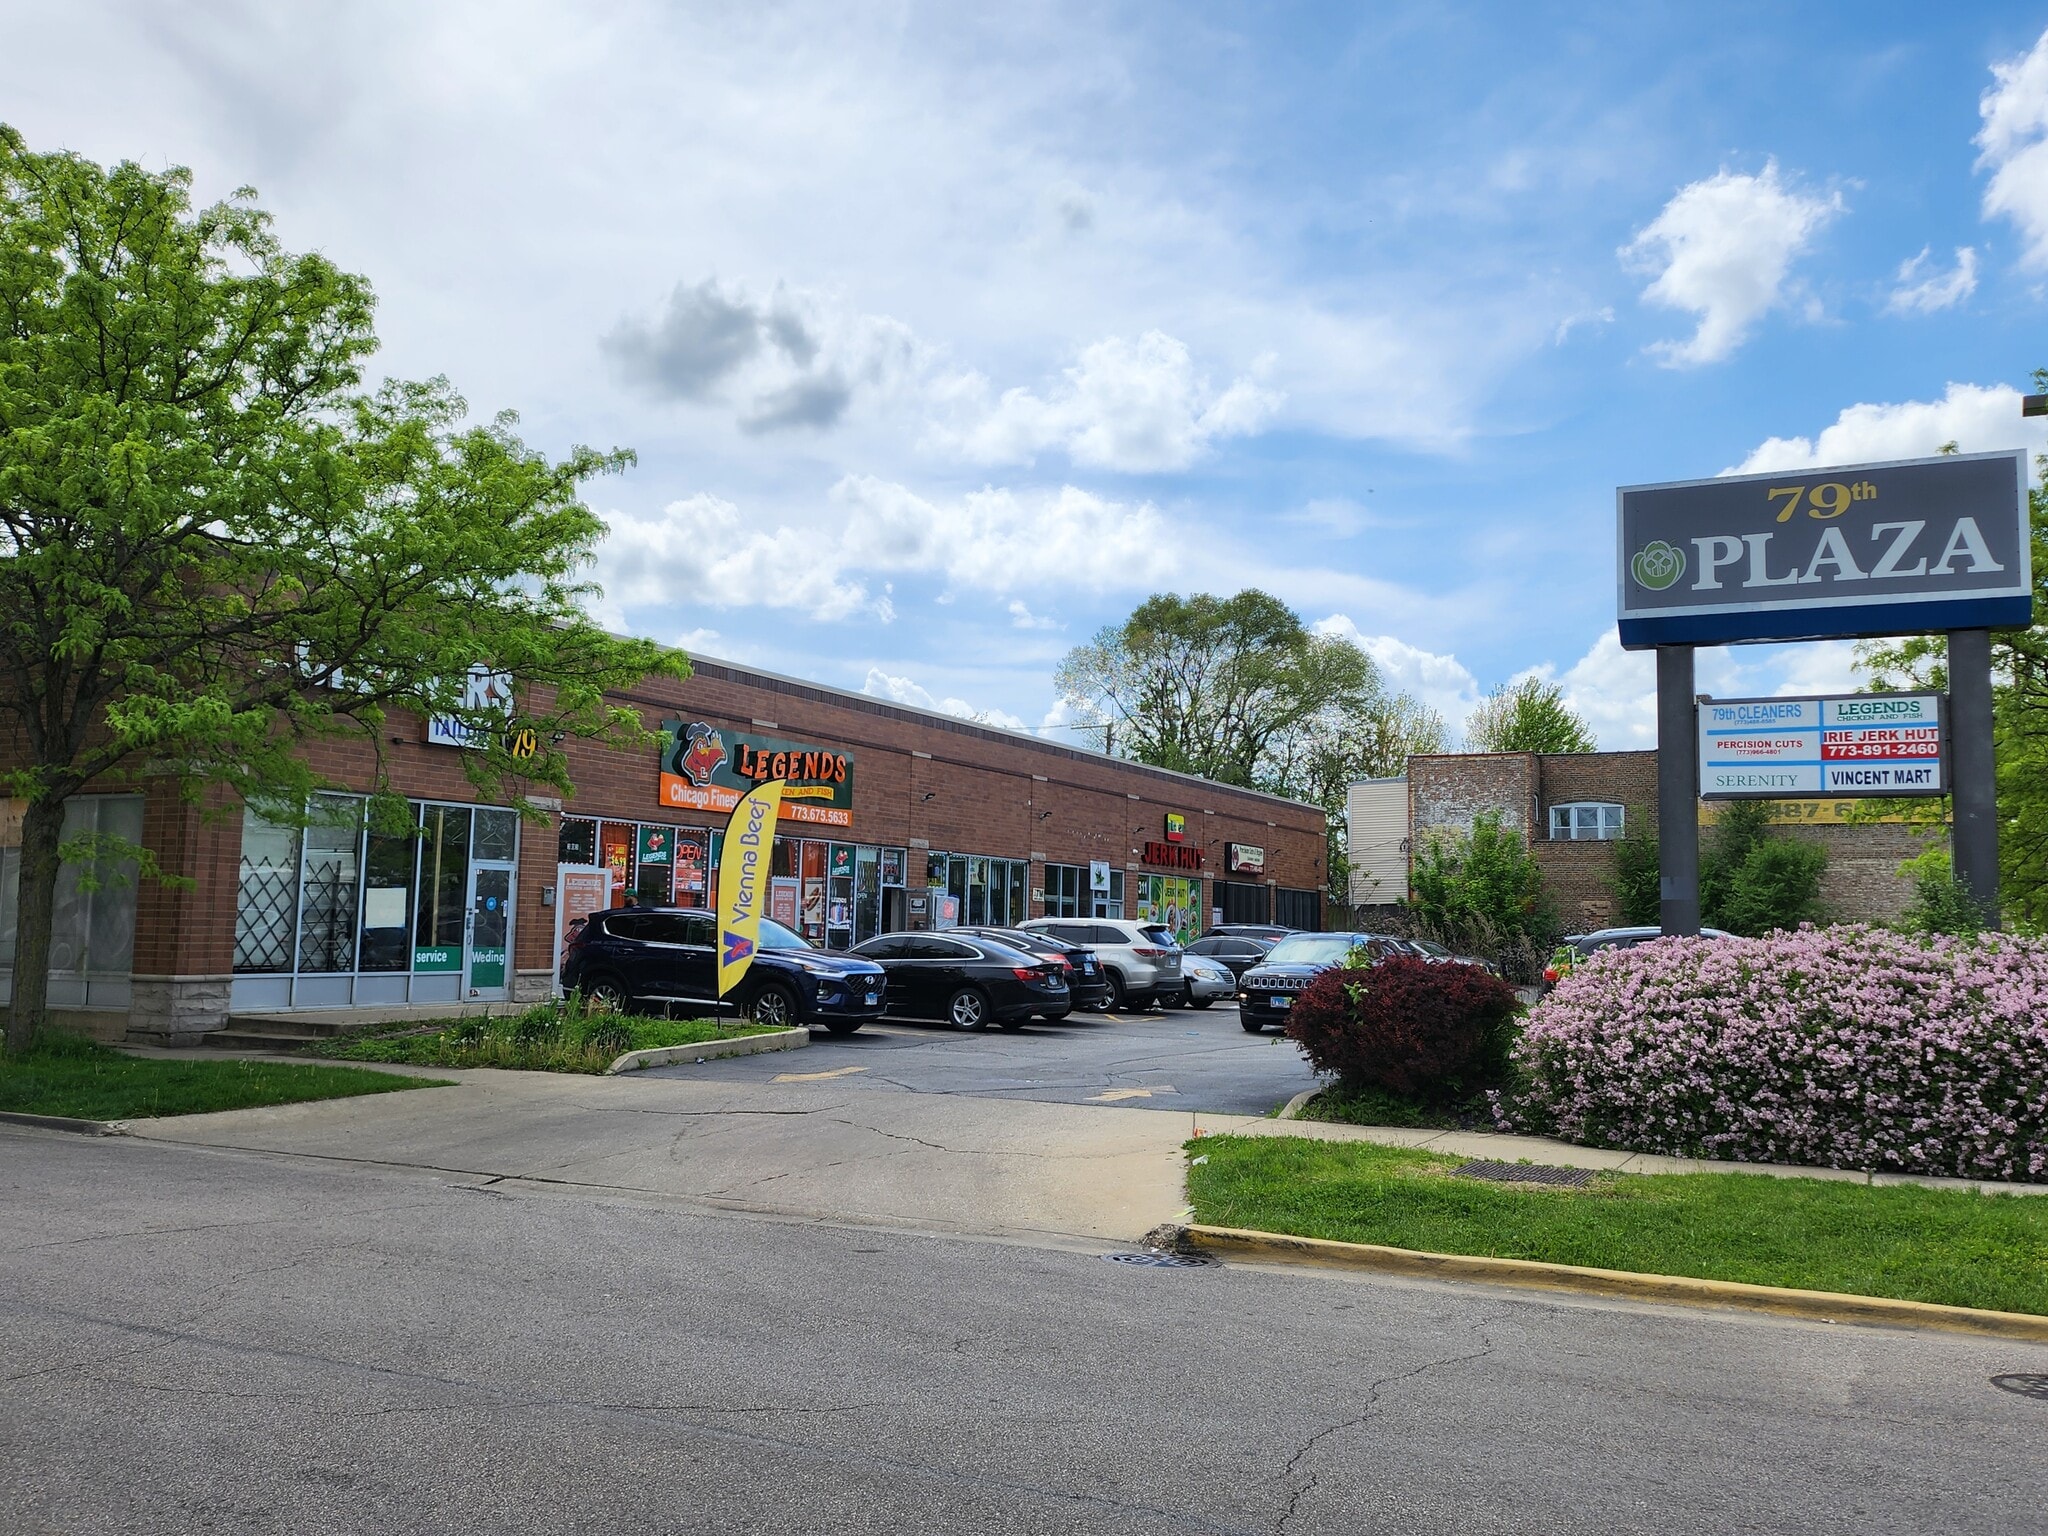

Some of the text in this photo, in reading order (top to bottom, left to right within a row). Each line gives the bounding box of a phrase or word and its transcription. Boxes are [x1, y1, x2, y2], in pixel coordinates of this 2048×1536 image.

[1768, 480, 1877, 523] 79th
[1691, 516, 2004, 591] PLAZA
[1712, 704, 1802, 720] 79th CLEANERS
[1838, 701, 1920, 715] LEGENDS
[1717, 740, 1803, 748] PERCISION CUTS
[1823, 729, 1938, 743] IRIE JERK HUT
[1828, 743, 1938, 757] 773-891-2460
[741, 743, 847, 783] LEGENDS
[1716, 774, 1798, 787] SERENITY
[1831, 769, 1932, 785] VINCENT MART
[670, 783, 739, 809] Chicago Finest
[791, 805, 849, 824] 773.675.5633
[676, 843, 702, 860] OPEN
[1144, 841, 1204, 868] JERK HUT
[732, 797, 771, 925] Vienna Beef
[416, 949, 505, 966] service Weding
